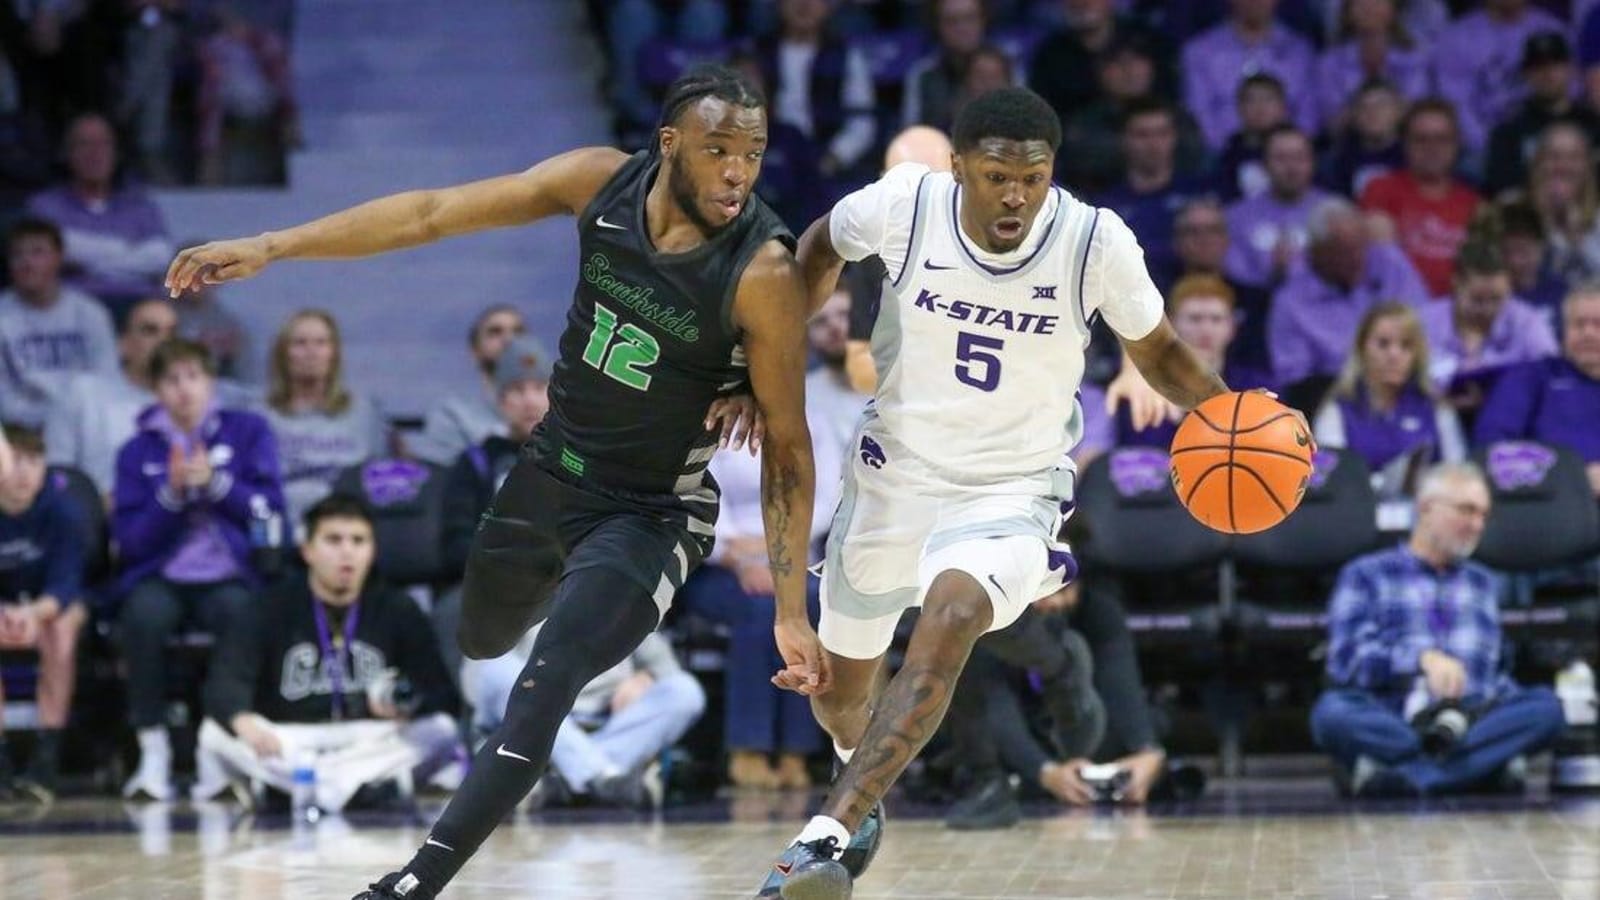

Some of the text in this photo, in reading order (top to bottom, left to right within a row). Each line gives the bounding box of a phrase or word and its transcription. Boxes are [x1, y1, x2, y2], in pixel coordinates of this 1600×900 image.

[584, 252, 699, 341] Southside
[914, 288, 1060, 335] K-STATE
[582, 301, 660, 392] 12
[955, 331, 1005, 393] 5
